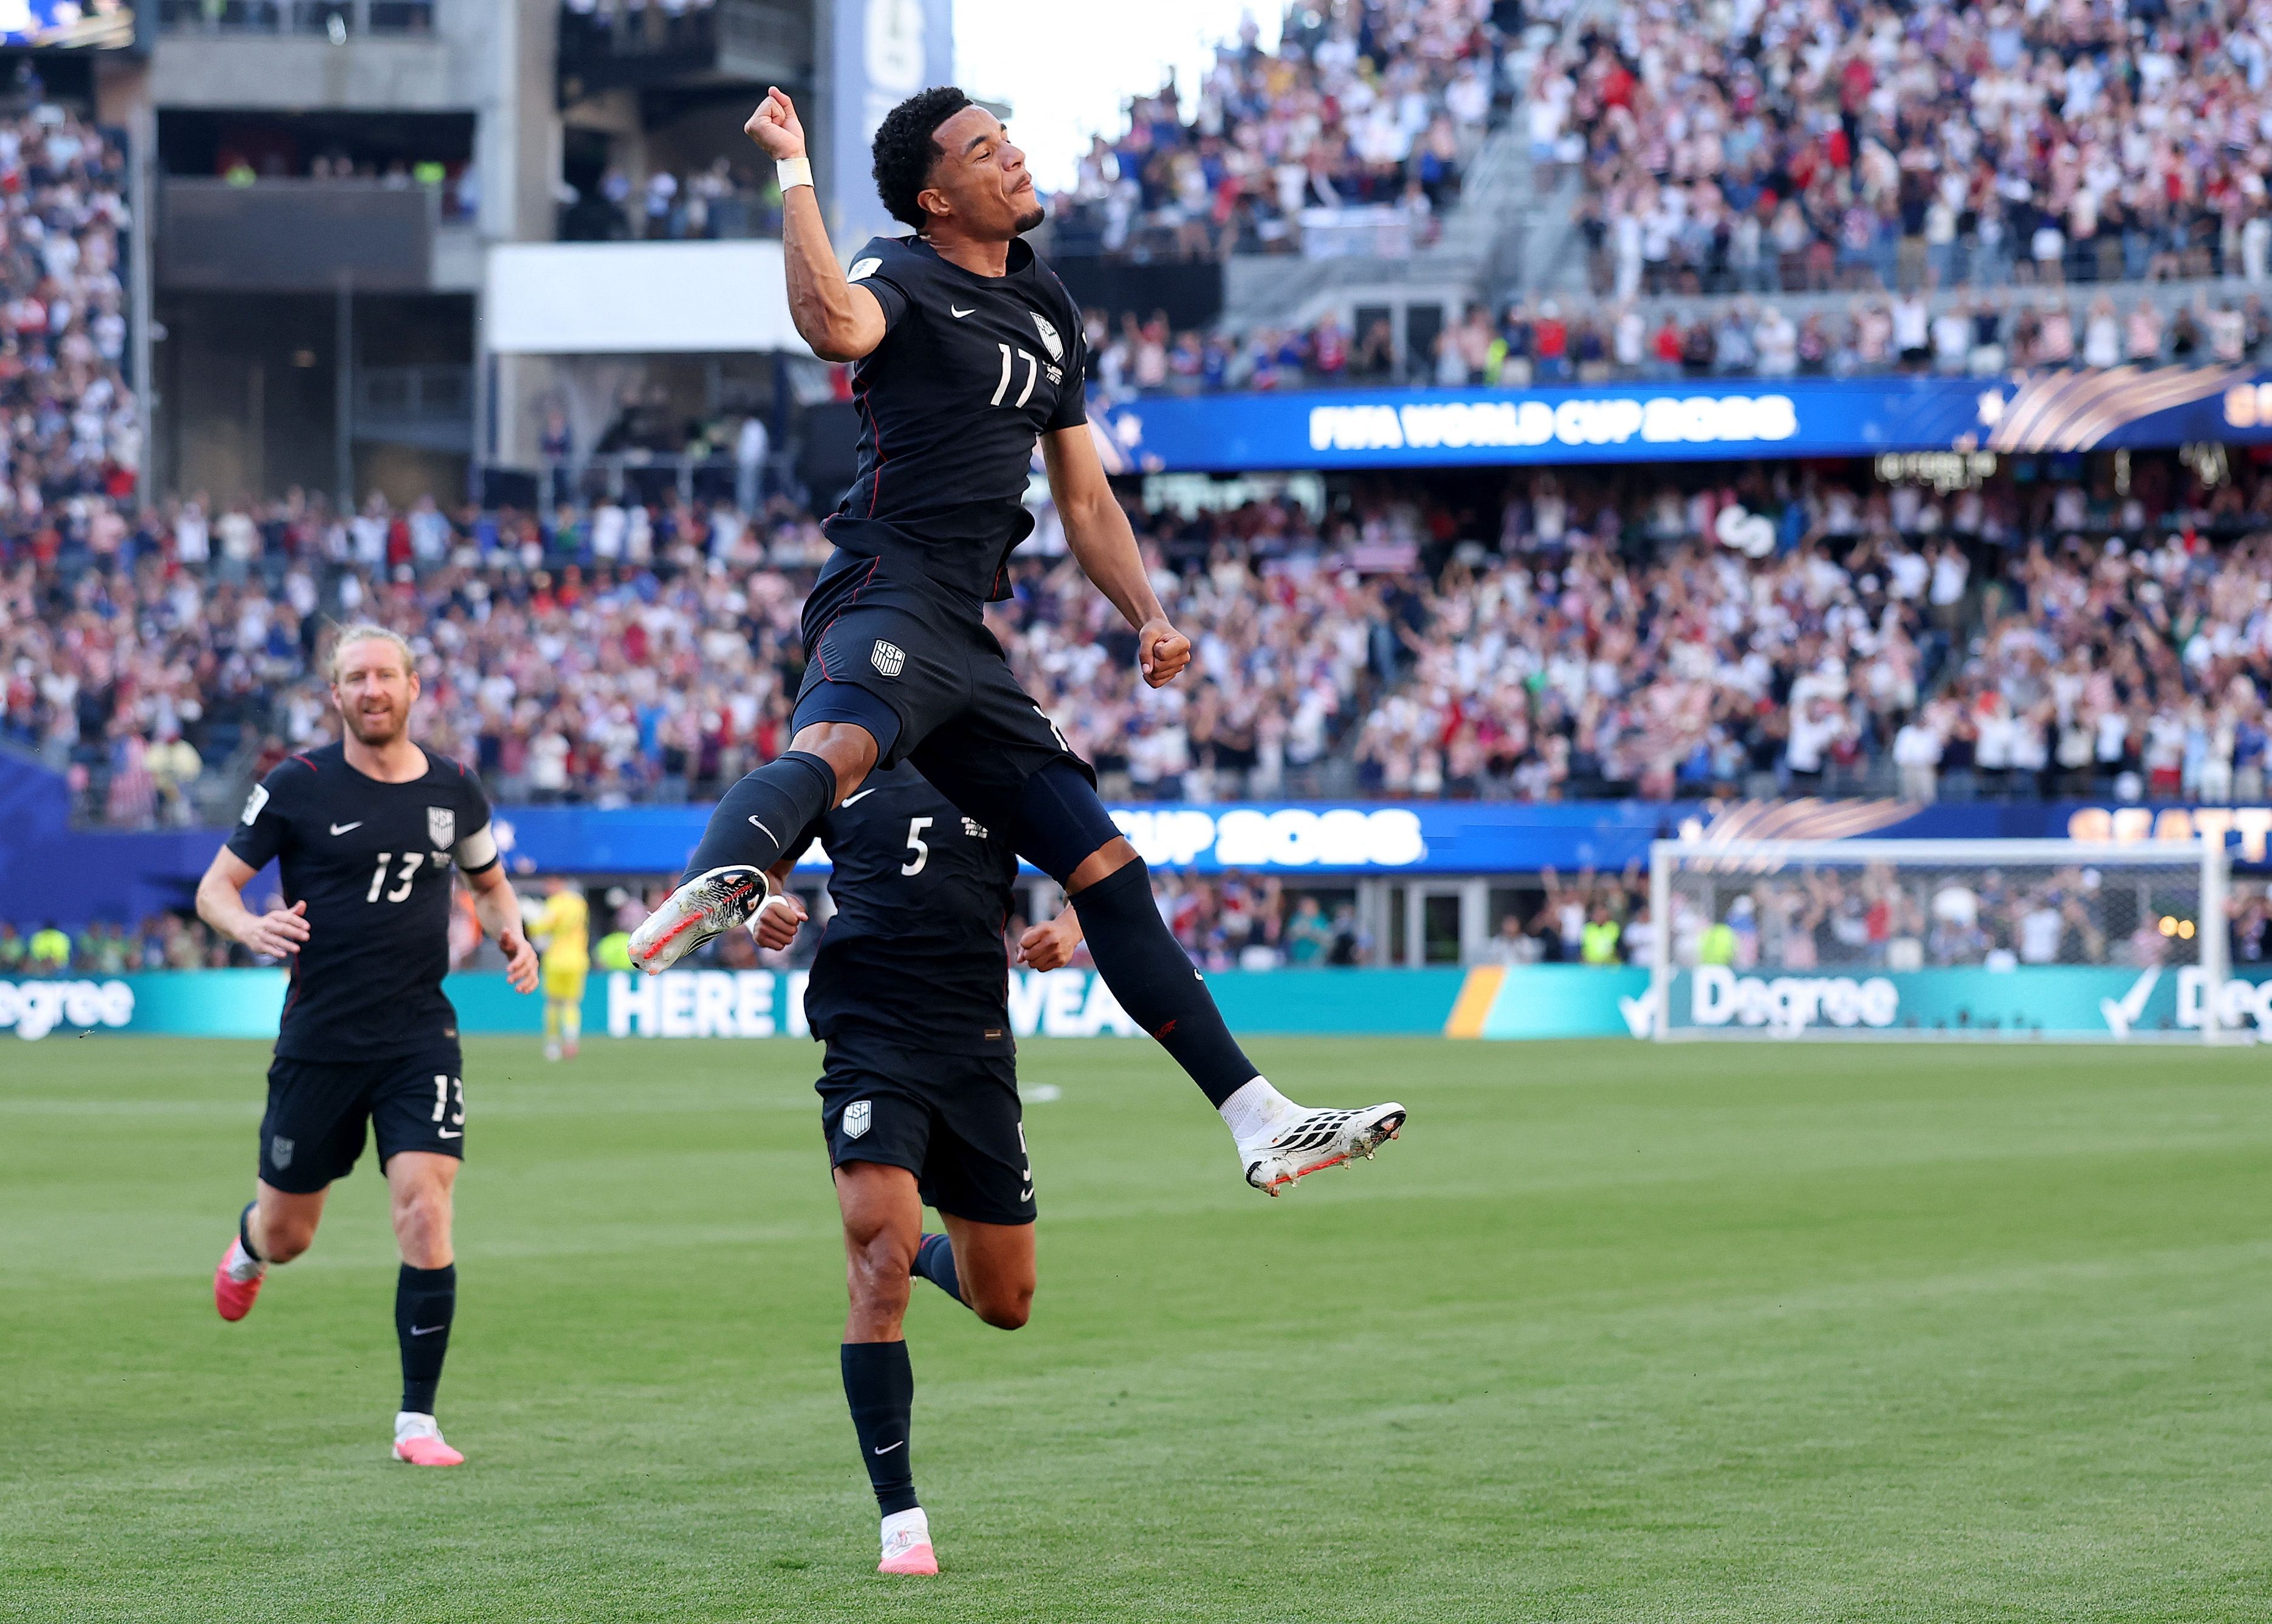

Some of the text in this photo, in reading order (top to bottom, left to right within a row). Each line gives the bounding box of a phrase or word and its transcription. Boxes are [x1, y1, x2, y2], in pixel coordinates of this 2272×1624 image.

[990, 343, 1037, 408] 17
[1309, 394, 1797, 451] FIFA WORLD CUP 2026
[877, 642, 904, 661] USA
[901, 817, 933, 876] 5
[1215, 809, 1424, 865] 2026
[366, 852, 425, 903] 13
[608, 969, 777, 1038] HERE
[1691, 964, 1899, 1040] Degree
[431, 1074, 465, 1126] 13
[845, 1103, 868, 1118] USA
